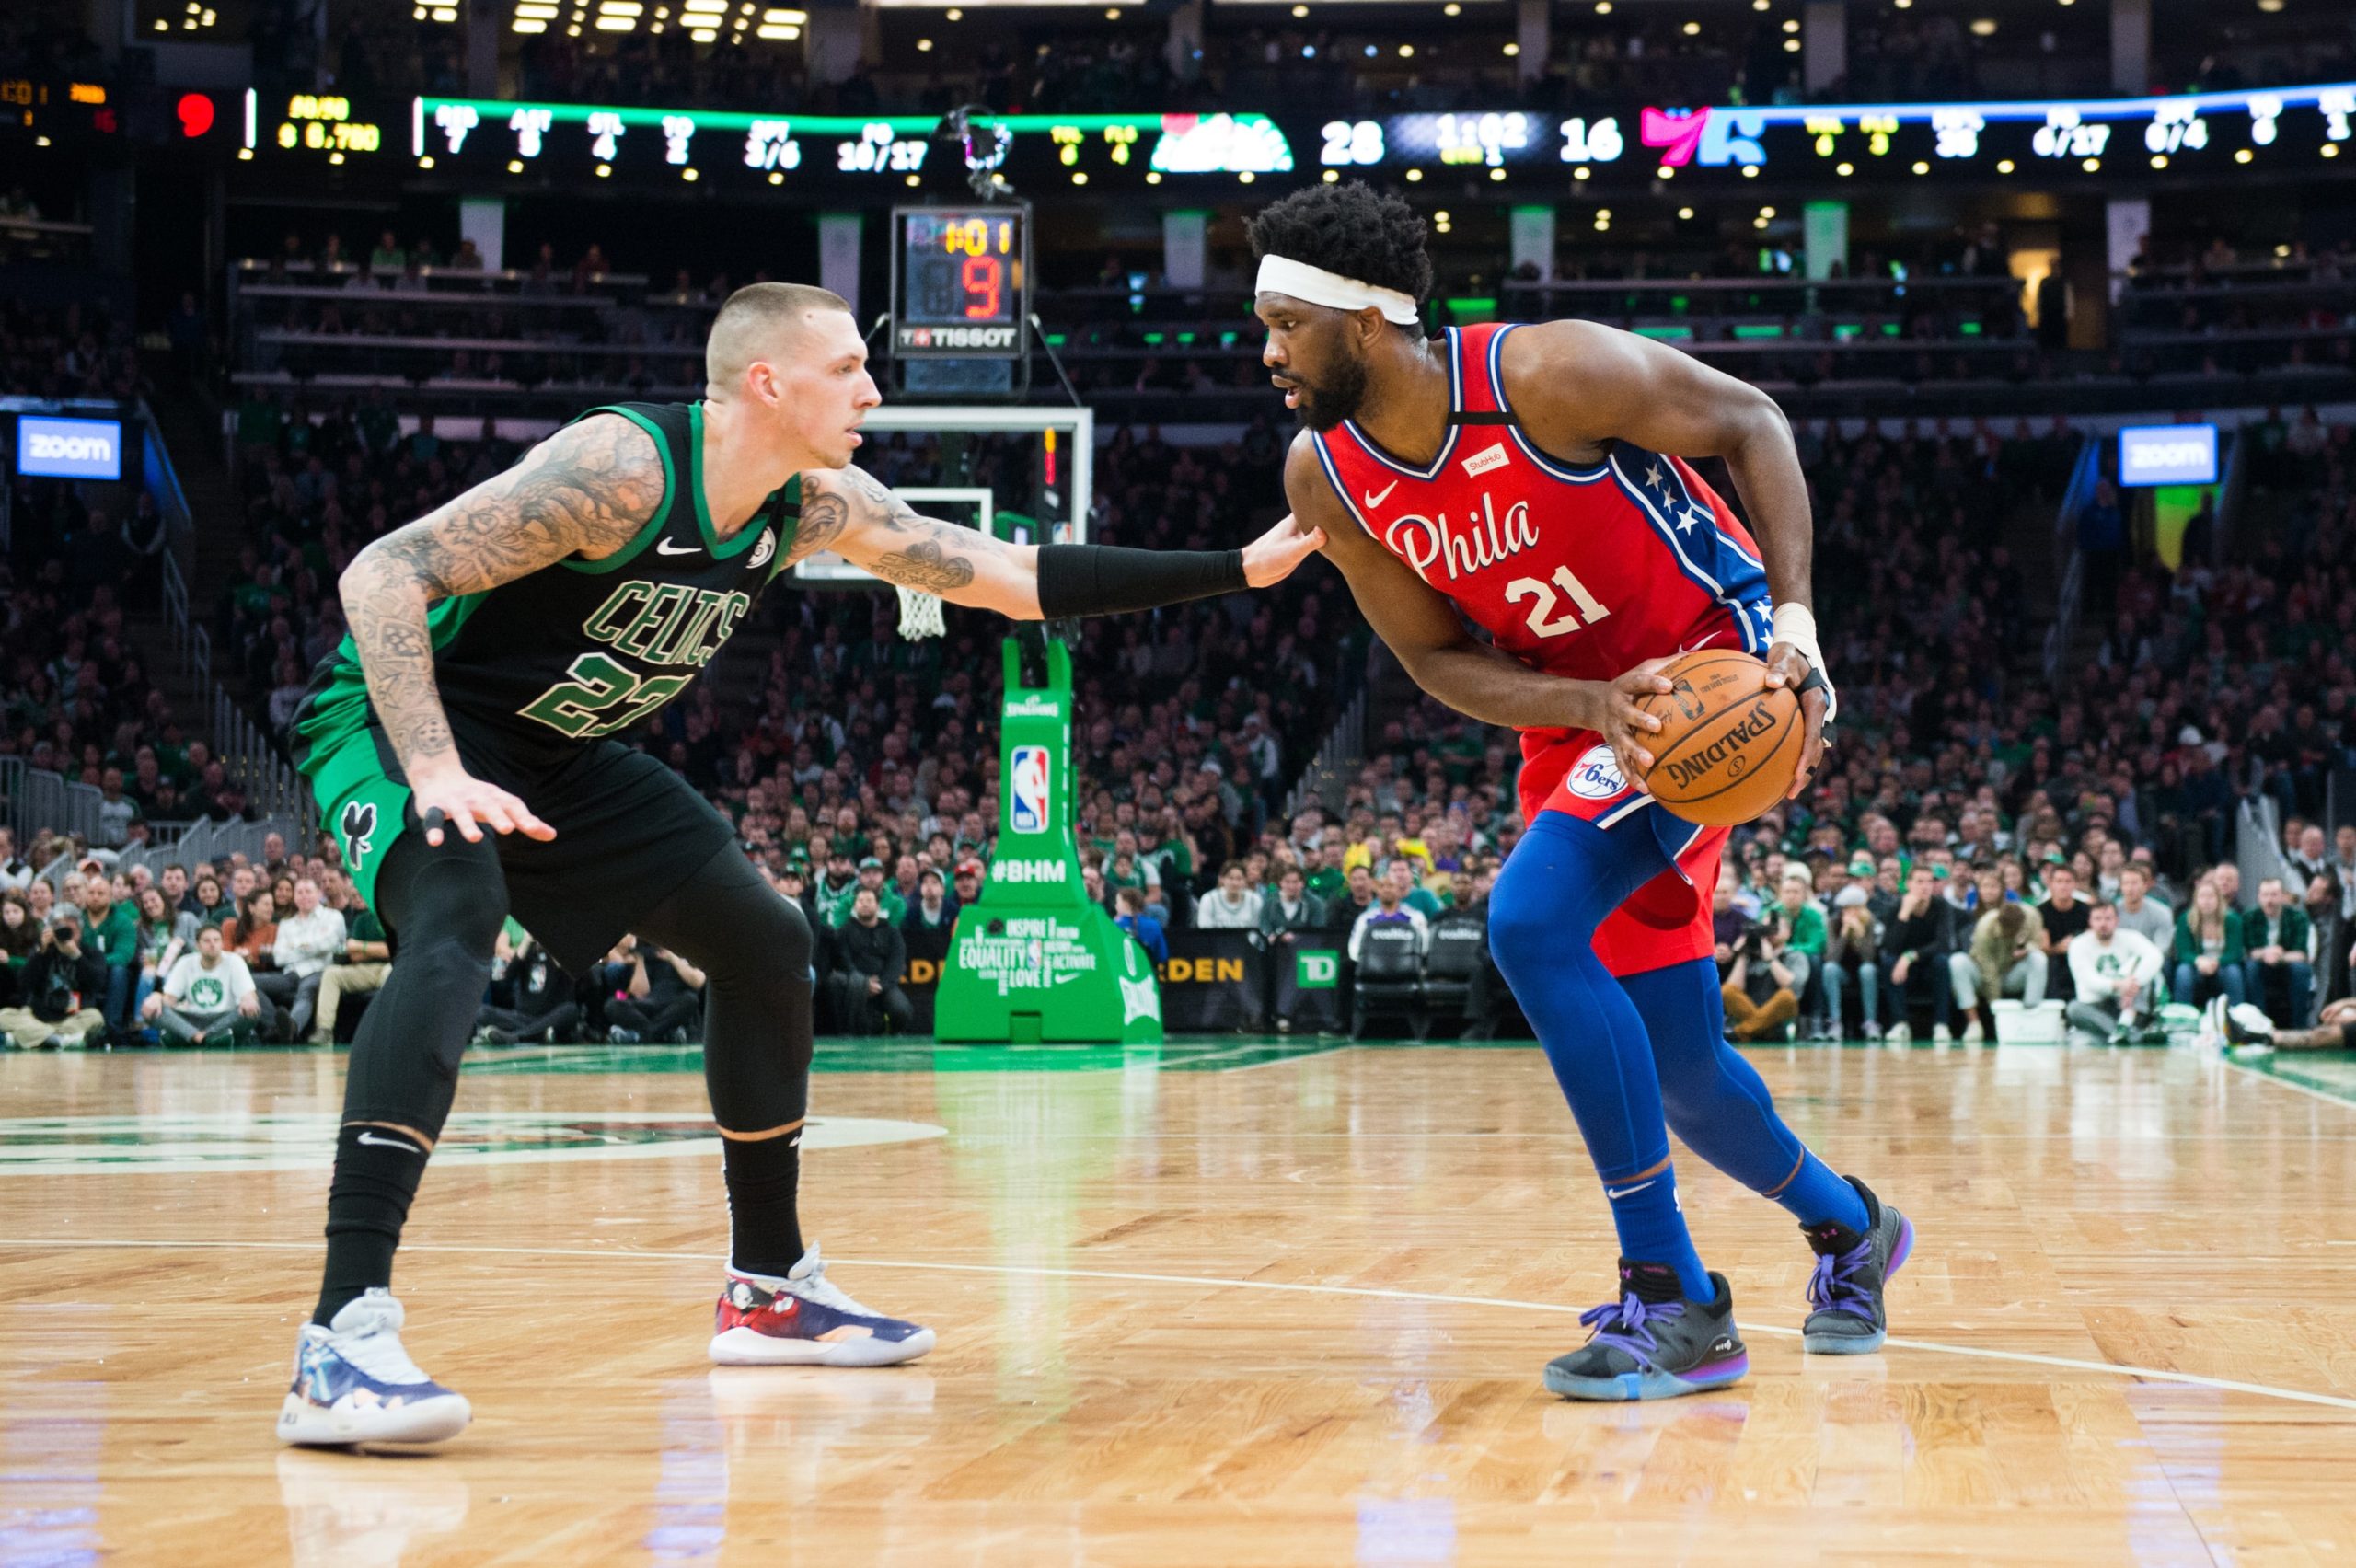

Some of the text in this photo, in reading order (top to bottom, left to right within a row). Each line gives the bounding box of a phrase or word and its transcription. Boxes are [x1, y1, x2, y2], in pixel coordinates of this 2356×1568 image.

[1321, 121, 1384, 166] 28
[1436, 113, 1527, 149] 1:02
[1561, 118, 1623, 161] 16
[1641, 105, 1767, 167] 76
[838, 142, 928, 172] 10/17
[945, 219, 1011, 257] 1:01
[962, 255, 999, 318] 9
[932, 327, 1016, 348] TISSOT
[29, 433, 112, 462] zoom
[2130, 441, 2209, 469] zoom
[1385, 491, 1540, 586] Phila
[1504, 565, 1611, 639] 21
[1664, 699, 1777, 790] SPALDING
[1574, 763, 1619, 790] 76ers
[992, 859, 1066, 882] #BHM
[1006, 918, 1046, 939] INSPIRE
[959, 945, 1026, 970] EQUALITY
[1052, 953, 1096, 971] ACTIVATE
[1300, 956, 1335, 981] TD
[1009, 969, 1041, 988] LOVE
